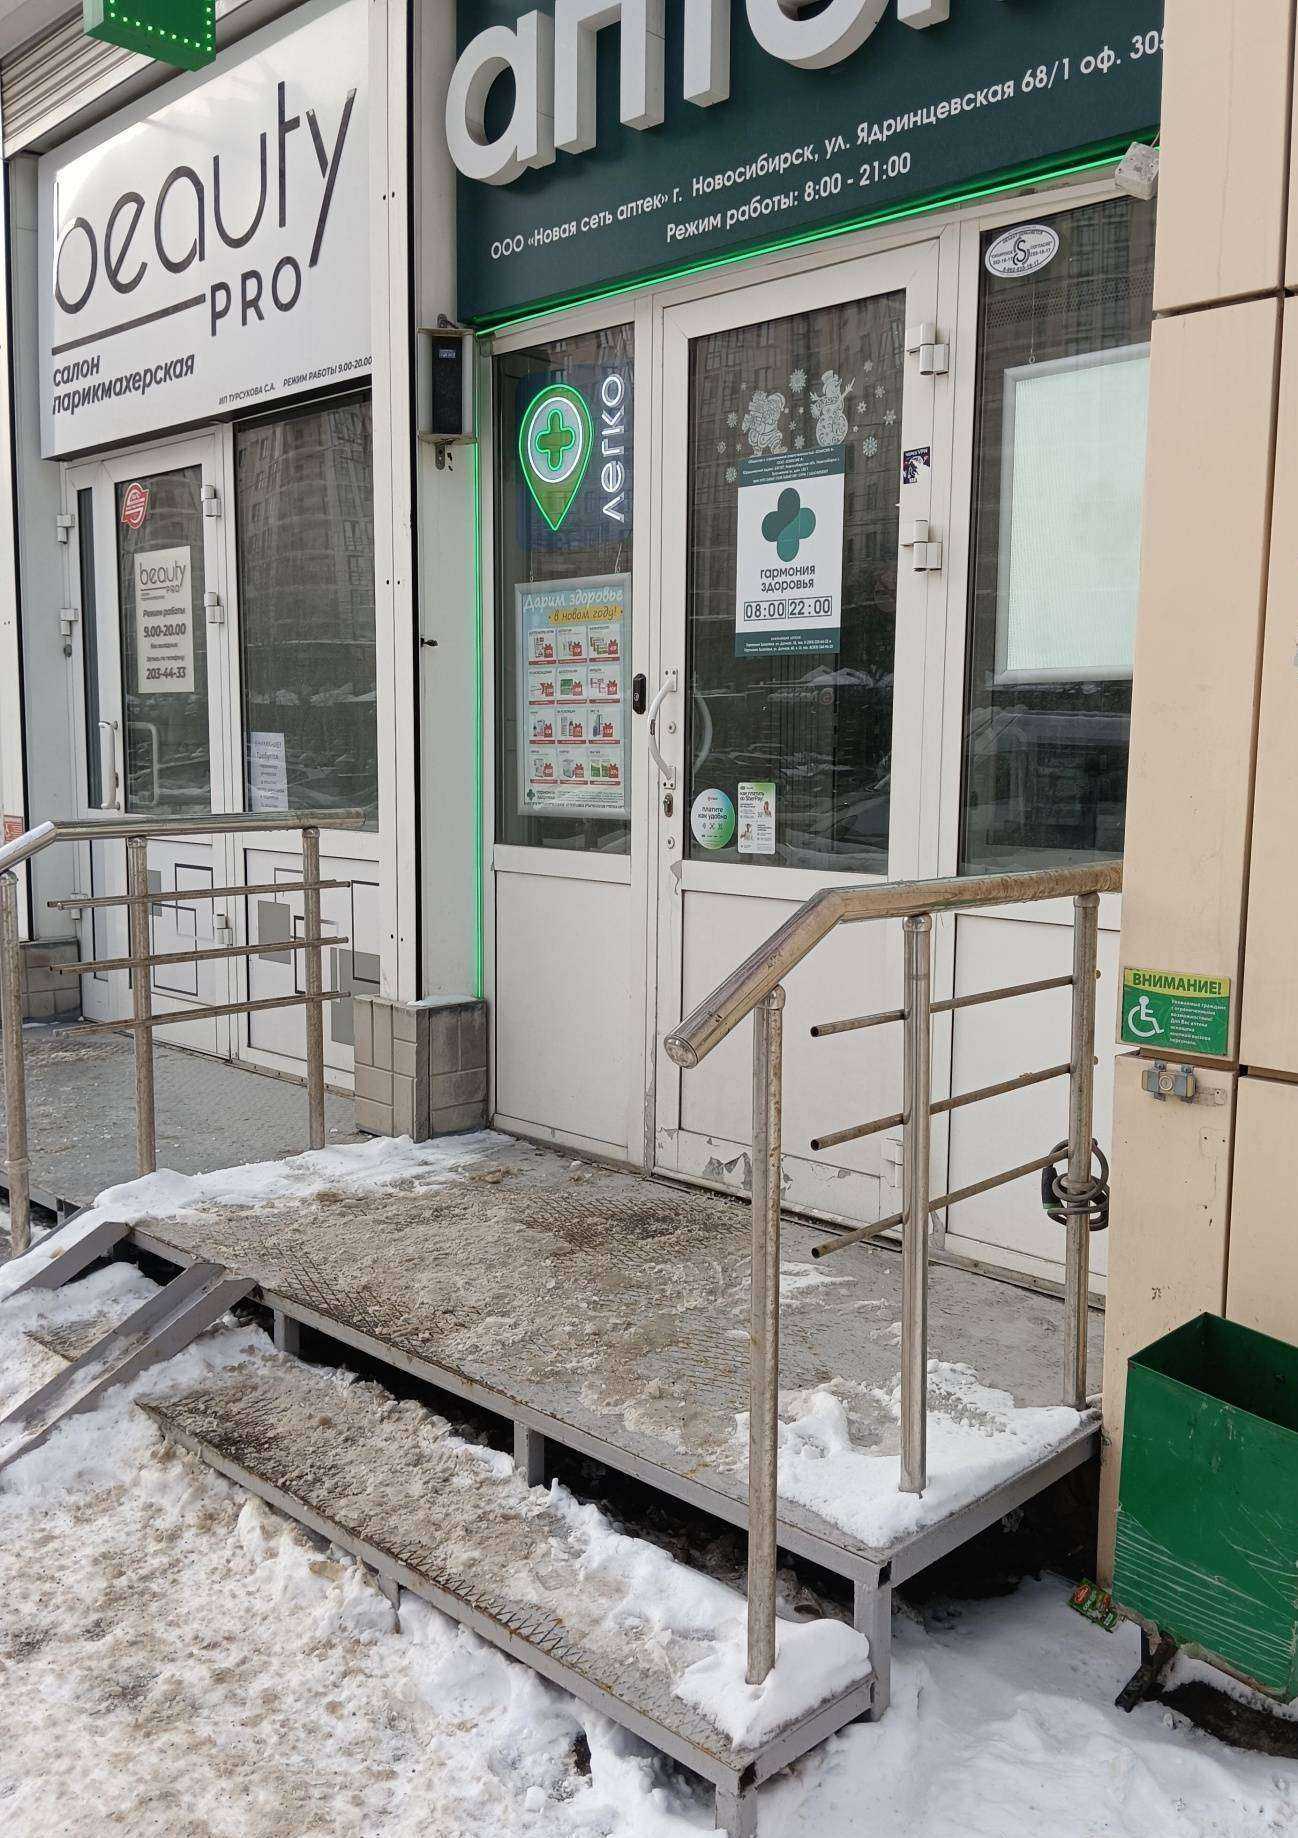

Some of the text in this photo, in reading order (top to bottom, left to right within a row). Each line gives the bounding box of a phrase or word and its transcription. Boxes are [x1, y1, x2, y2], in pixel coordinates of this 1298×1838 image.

[491, 234, 524, 260] ООО
[527, 220, 577, 247] «Новая
[580, 210, 613, 232] сеть
[617, 193, 669, 220] аптек»
[672, 187, 683, 204] г.
[692, 143, 819, 197] Новосибирск,
[824, 135, 850, 160] ул.
[856, 79, 1015, 146] Ядринцевская
[1021, 57, 1071, 93] 68/1
[1080, 45, 1121, 75] оф.
[55, 80, 357, 315] beauty
[666, 212, 722, 242] Режим
[726, 190, 799, 230] работы:
[804, 172, 842, 202] 8:00
[859, 151, 911, 187] 21:00
[210, 256, 302, 337] PRO
[52, 353, 195, 415] парикмахерская
[53, 354, 101, 387] салон
[218, 396, 228, 406] ИП
[283, 374, 308, 388] РЕЖИМ
[308, 365, 337, 381] РАБОТЫ
[338, 356, 373, 374] 9.00-20.00
[601, 374, 625, 523] легко
[139, 560, 186, 586] beauty
[760, 565, 816, 580] гармония
[761, 579, 814, 593] здоровья
[523, 586, 624, 613] Дарим здоровье
[562, 609, 590, 620] новом
[592, 605, 618, 621] году!
[745, 599, 831, 619] 08:00 22:00
[146, 666, 187, 681] 203-44-33
[1132, 972, 1222, 995] ВНИМАНИЕ!
